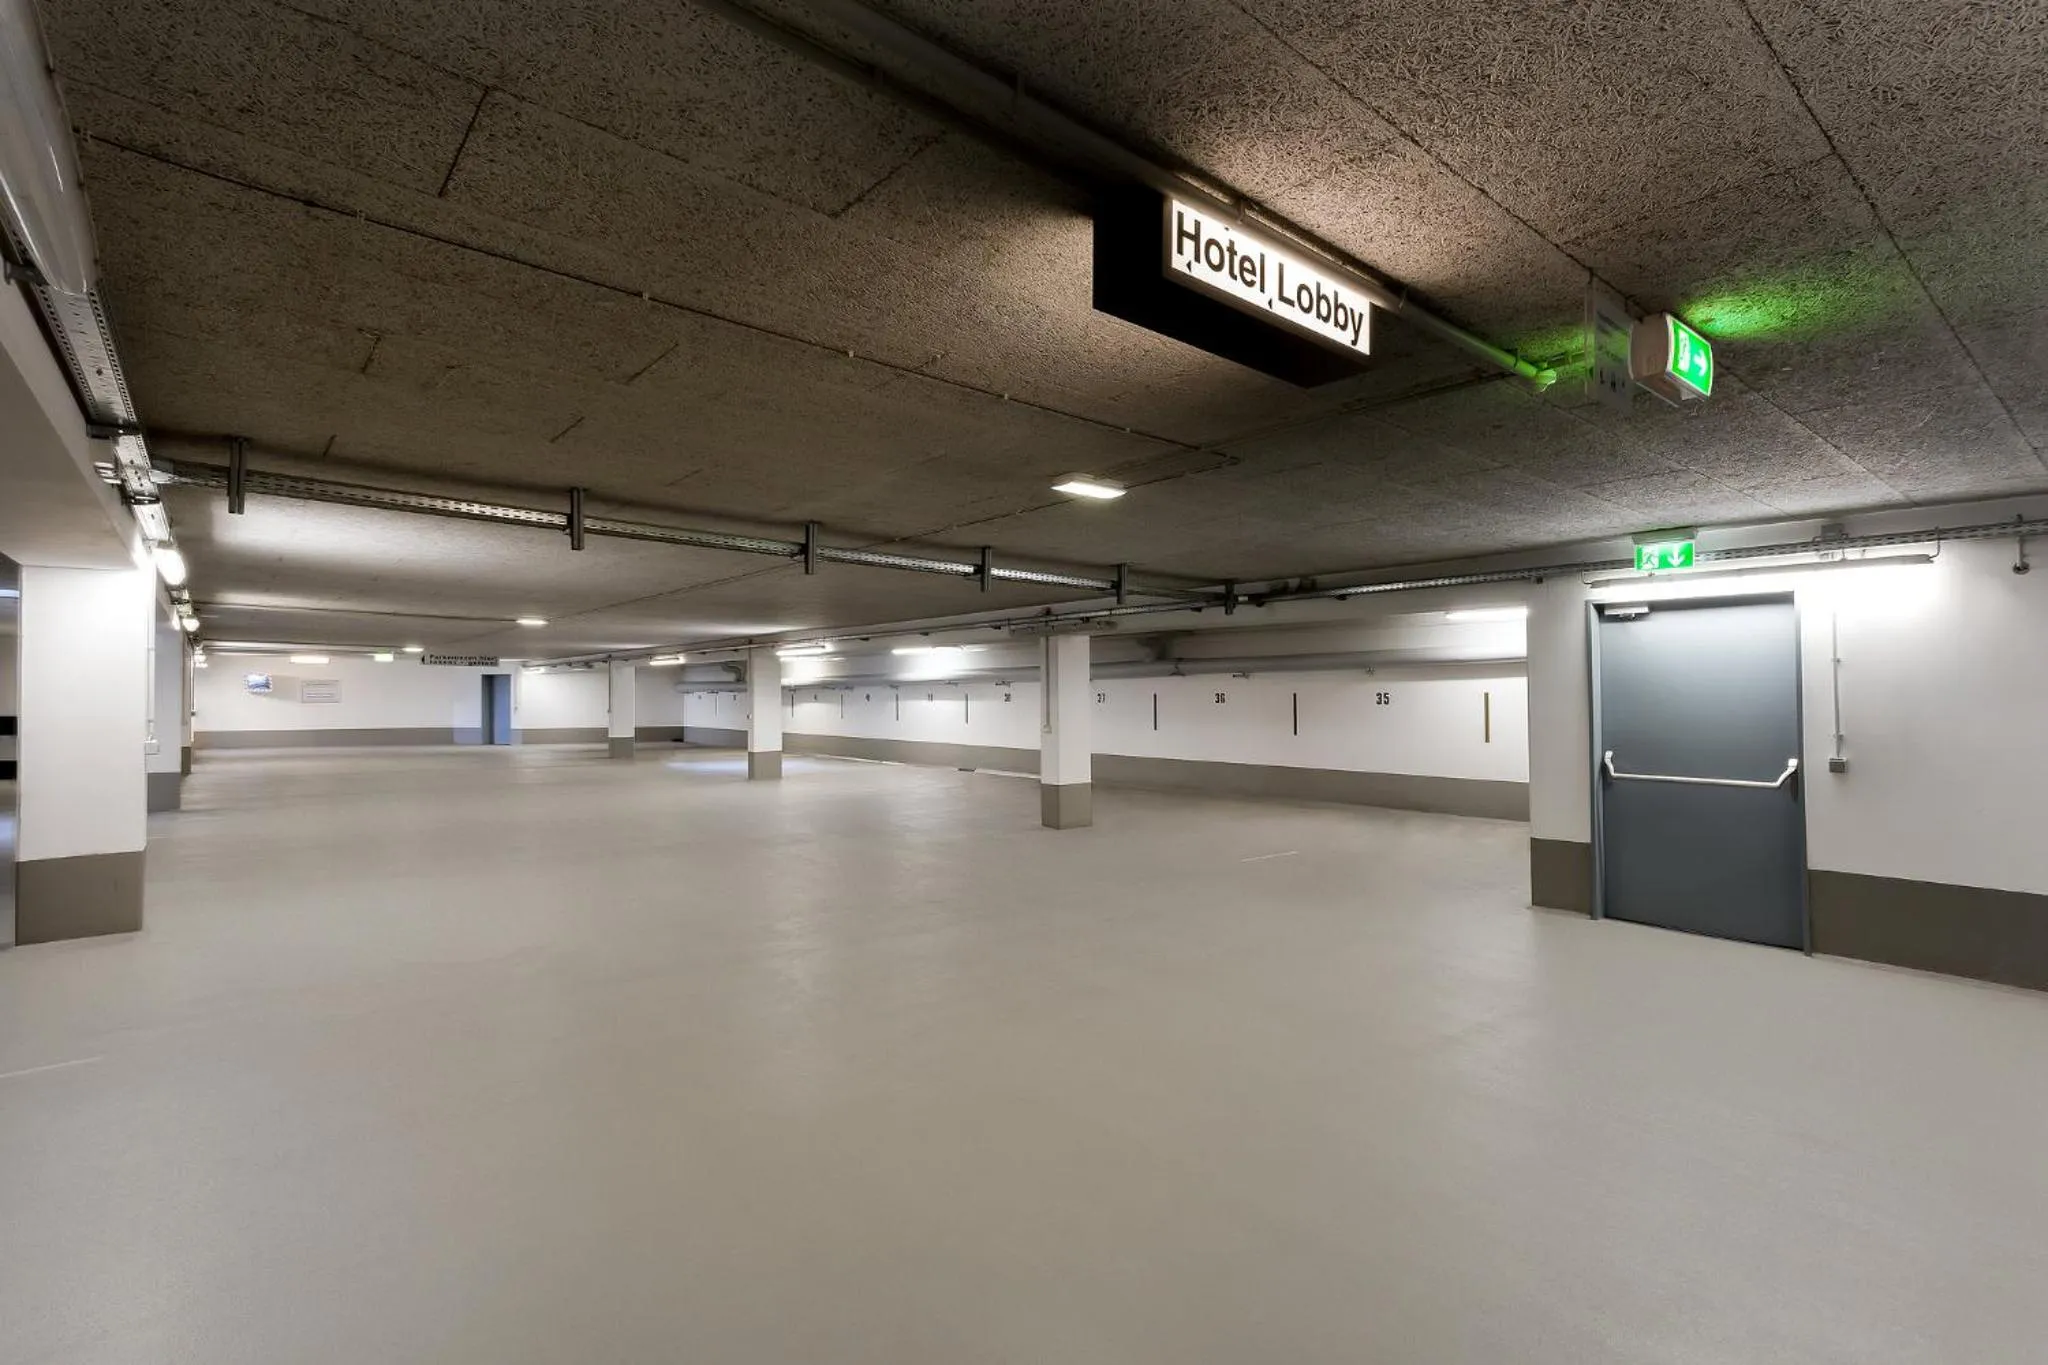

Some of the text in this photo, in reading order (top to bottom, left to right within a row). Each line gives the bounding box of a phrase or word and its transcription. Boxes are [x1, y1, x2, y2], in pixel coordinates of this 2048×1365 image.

[1176, 210, 1364, 346] Hotel Lobby
[1214, 692, 1227, 704] 36
[1376, 692, 1390, 705] 35
